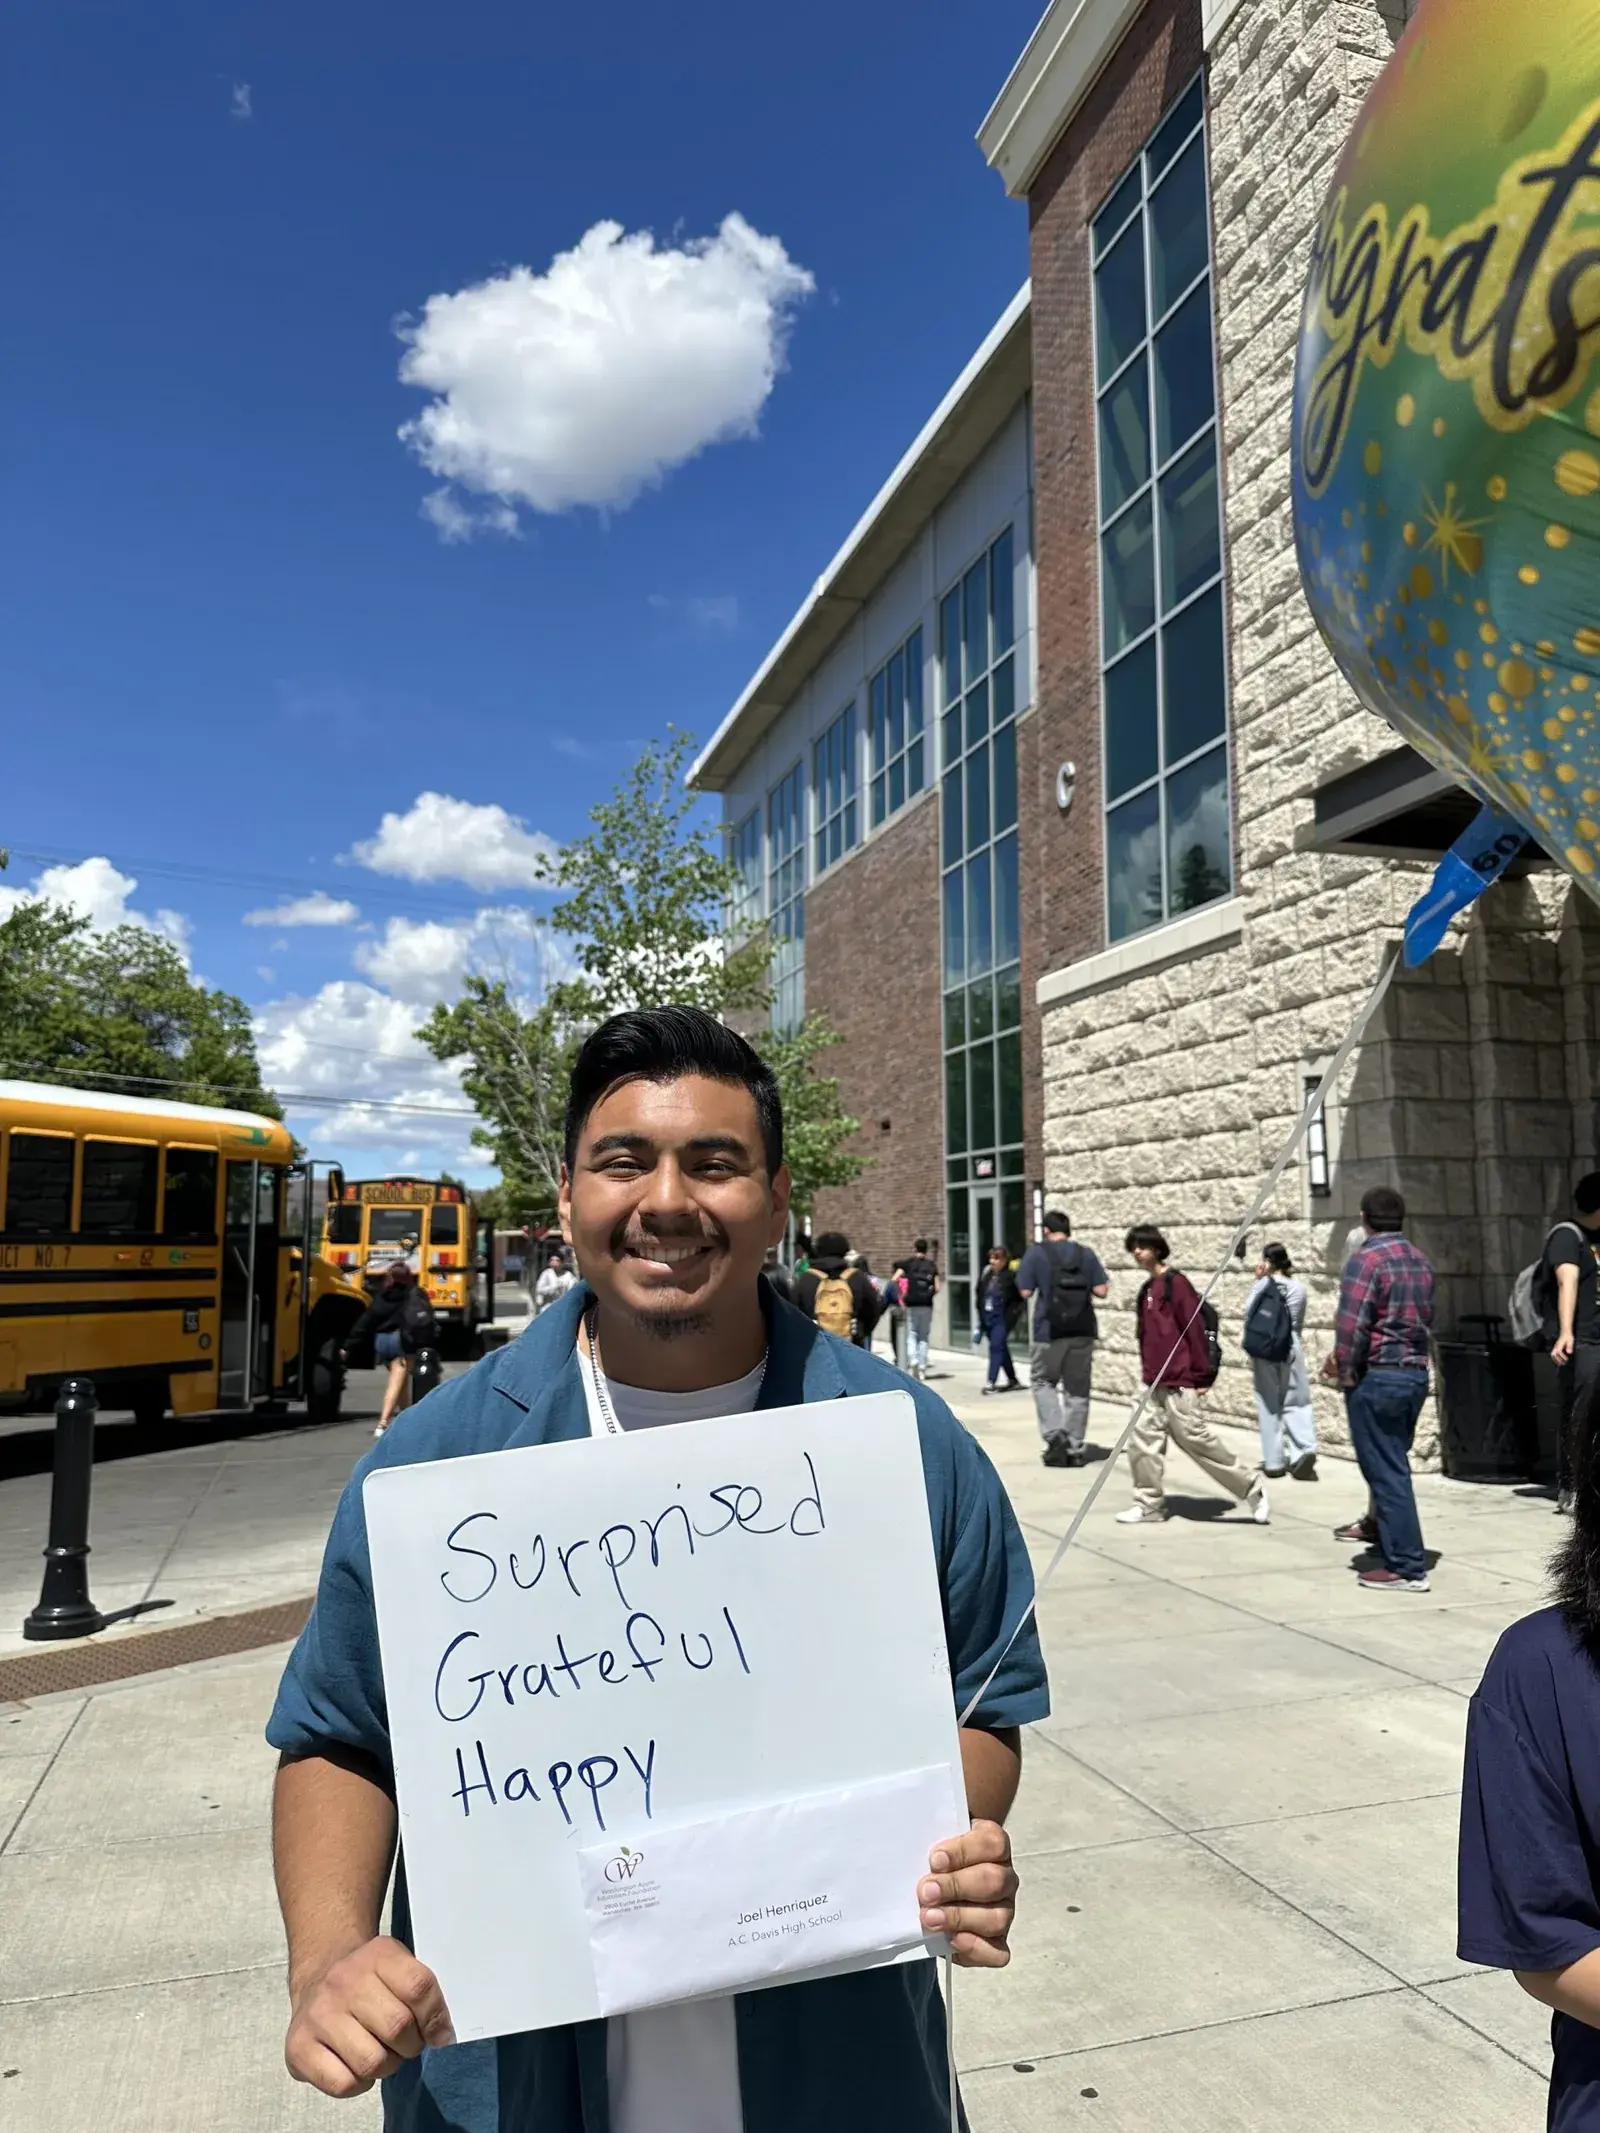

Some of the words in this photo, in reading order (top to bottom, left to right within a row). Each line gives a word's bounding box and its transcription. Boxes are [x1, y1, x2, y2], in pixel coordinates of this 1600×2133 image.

[411, 1186, 433, 1201] BUS
[64, 1246, 72, 1268] 7
[440, 1451, 826, 1610] Surprised
[434, 1606, 751, 1722] Grateful
[451, 1739, 656, 1832] Happy
[737, 1908, 762, 1925] Joel
[766, 1894, 828, 1918] Henriquez
[752, 1928, 780, 1942] Davis
[781, 1920, 806, 1934] High
[808, 1910, 842, 1928] School
